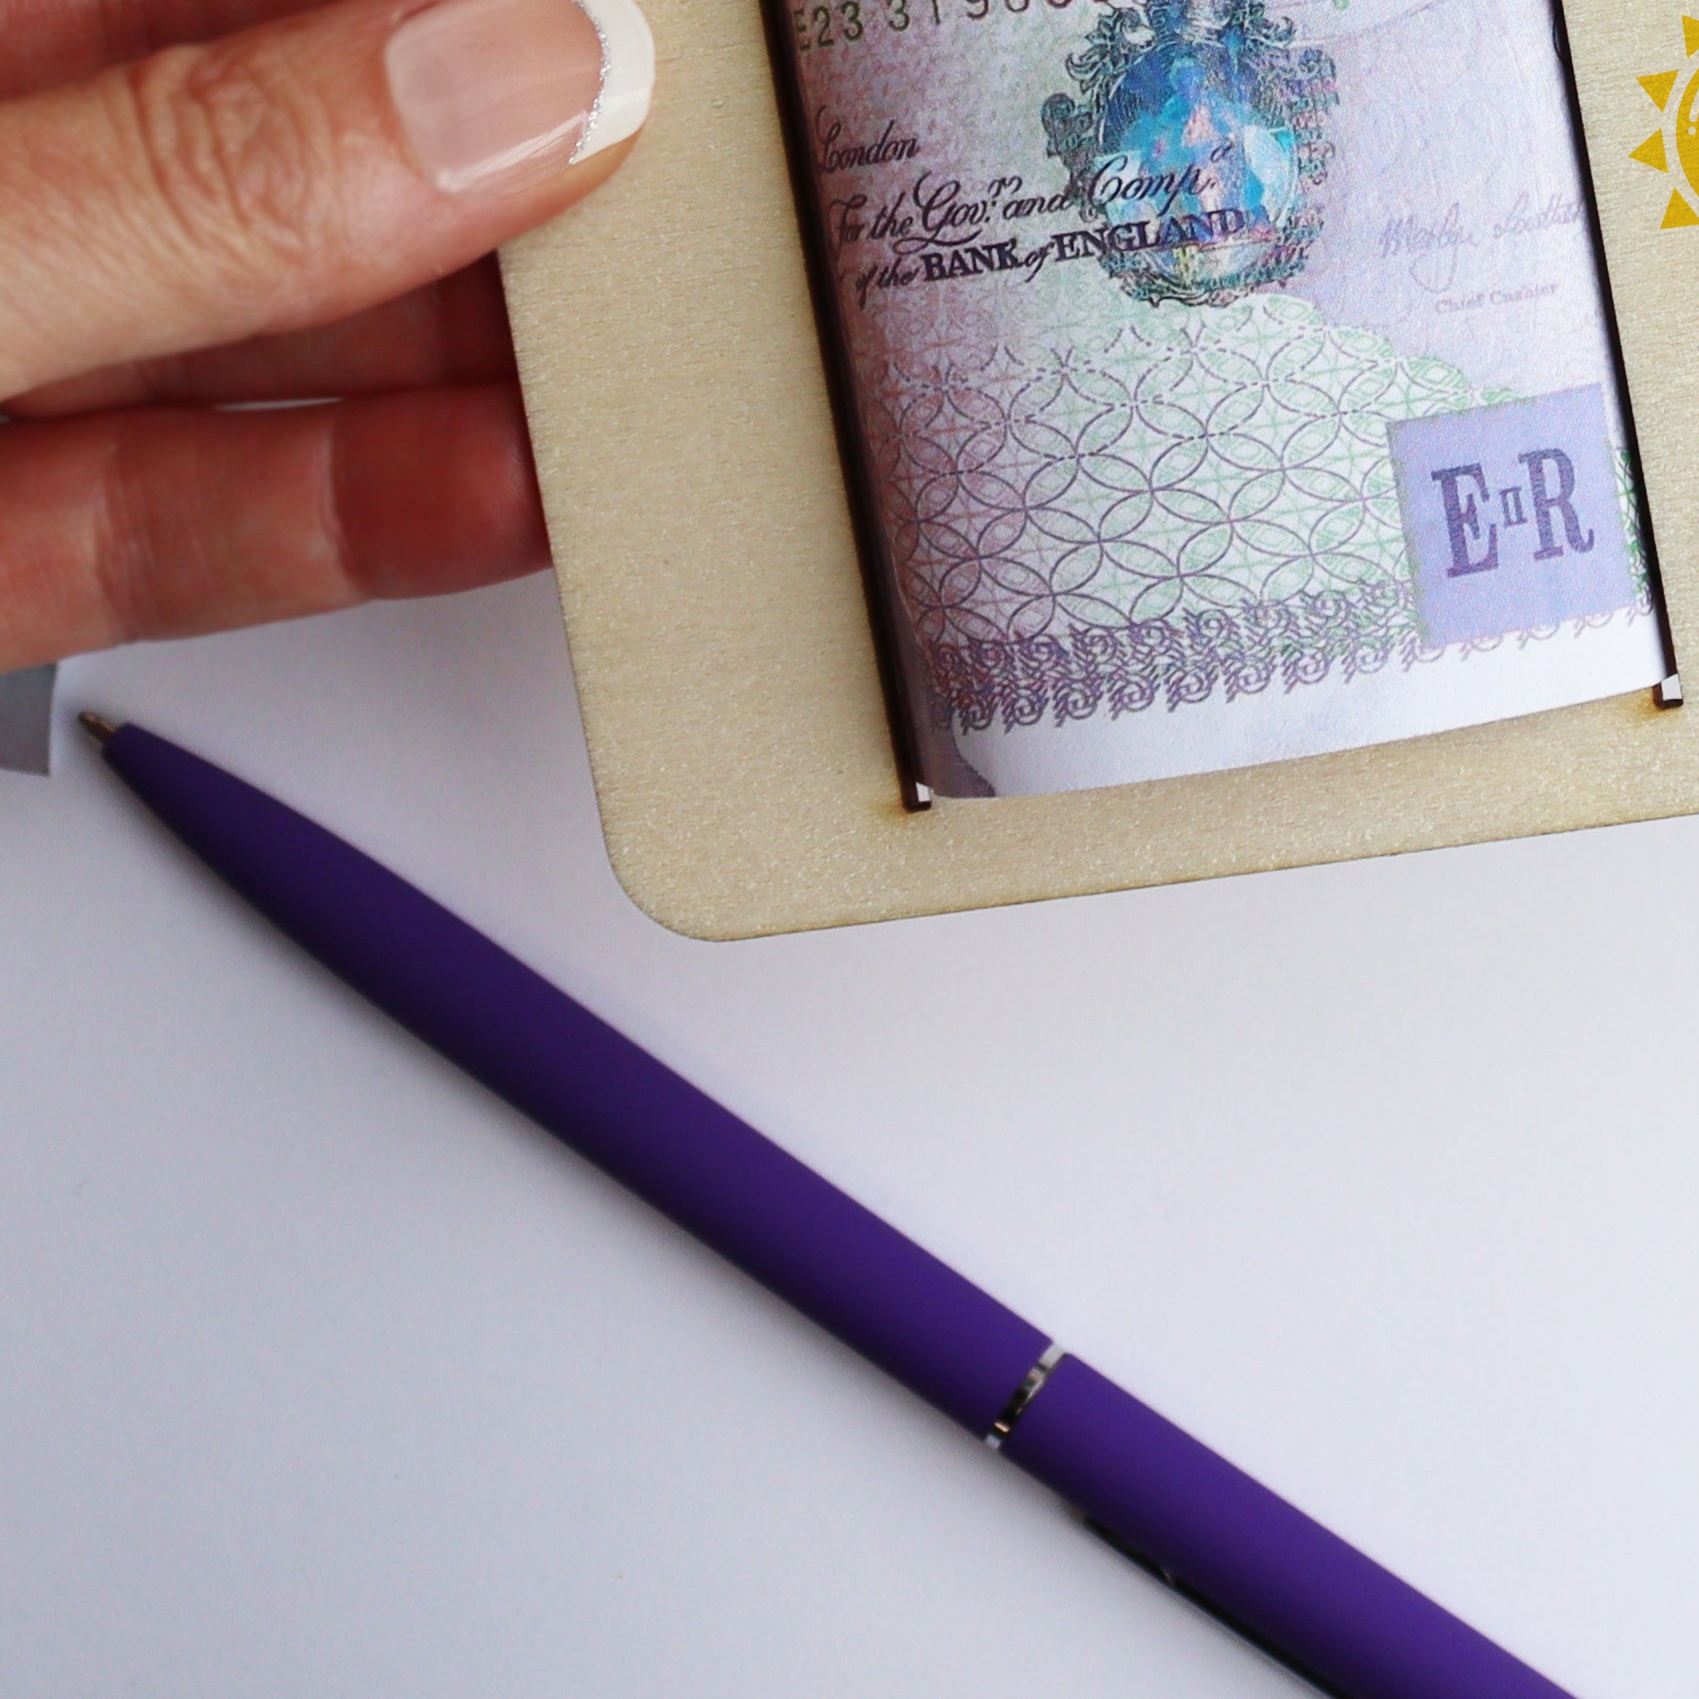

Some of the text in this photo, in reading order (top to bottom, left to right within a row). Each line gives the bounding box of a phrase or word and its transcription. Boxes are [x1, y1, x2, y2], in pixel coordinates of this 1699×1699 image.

[815, 105, 920, 173] London
[867, 191, 914, 240] the
[878, 256, 919, 290] the
[920, 237, 1020, 283] BANK
[1021, 240, 1056, 284] of
[1051, 207, 1247, 263] ENGLAND
